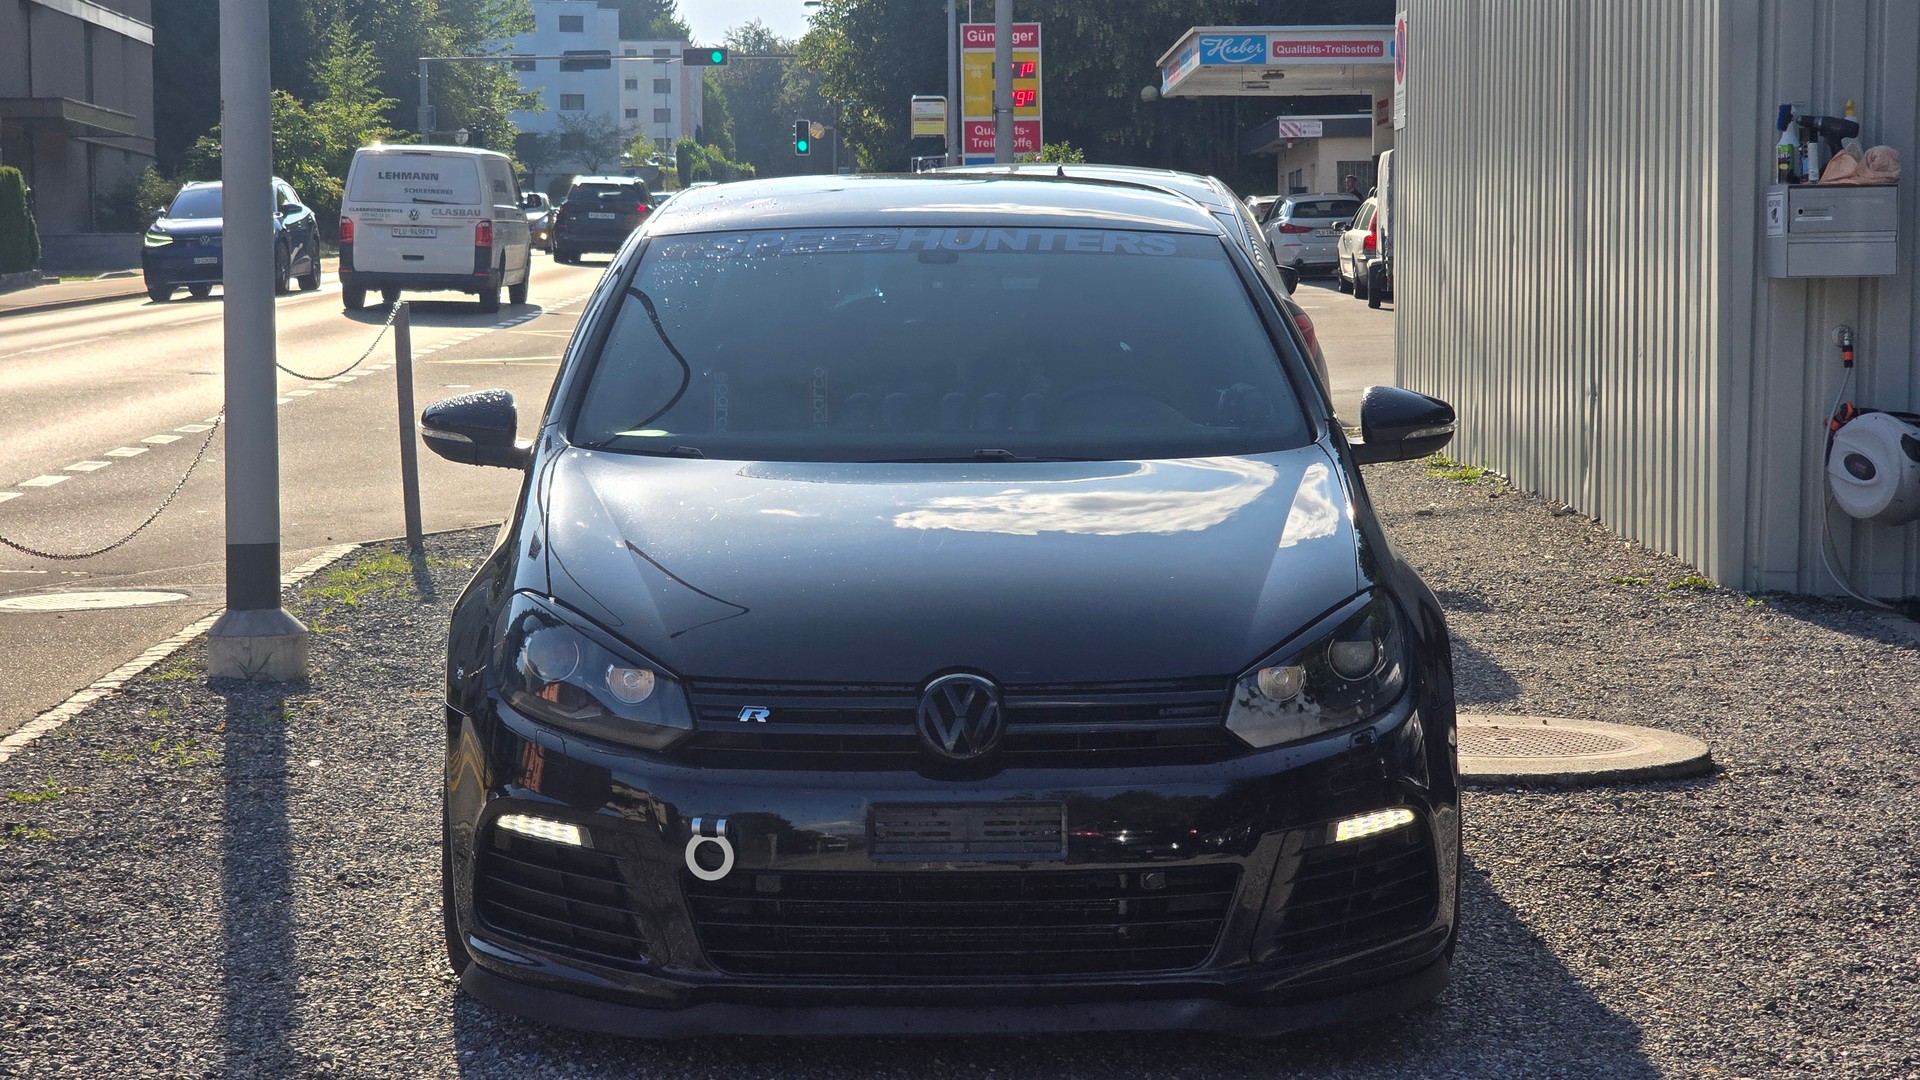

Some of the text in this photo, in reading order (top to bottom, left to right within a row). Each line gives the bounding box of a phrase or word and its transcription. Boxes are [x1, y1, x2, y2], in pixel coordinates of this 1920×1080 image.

[967, 30, 1034, 44] Günger
[1201, 38, 1264, 62] Huber
[1276, 43, 1380, 55] Qualitäts-Treibstoffe
[974, 125, 1030, 136] Quats-
[972, 137, 1032, 148] Treioffe
[378, 171, 439, 181] LEHMANN
[431, 208, 481, 217] GLASBAU
[706, 228, 1177, 257] SPEEDHUNTERS
[737, 705, 770, 723] R
